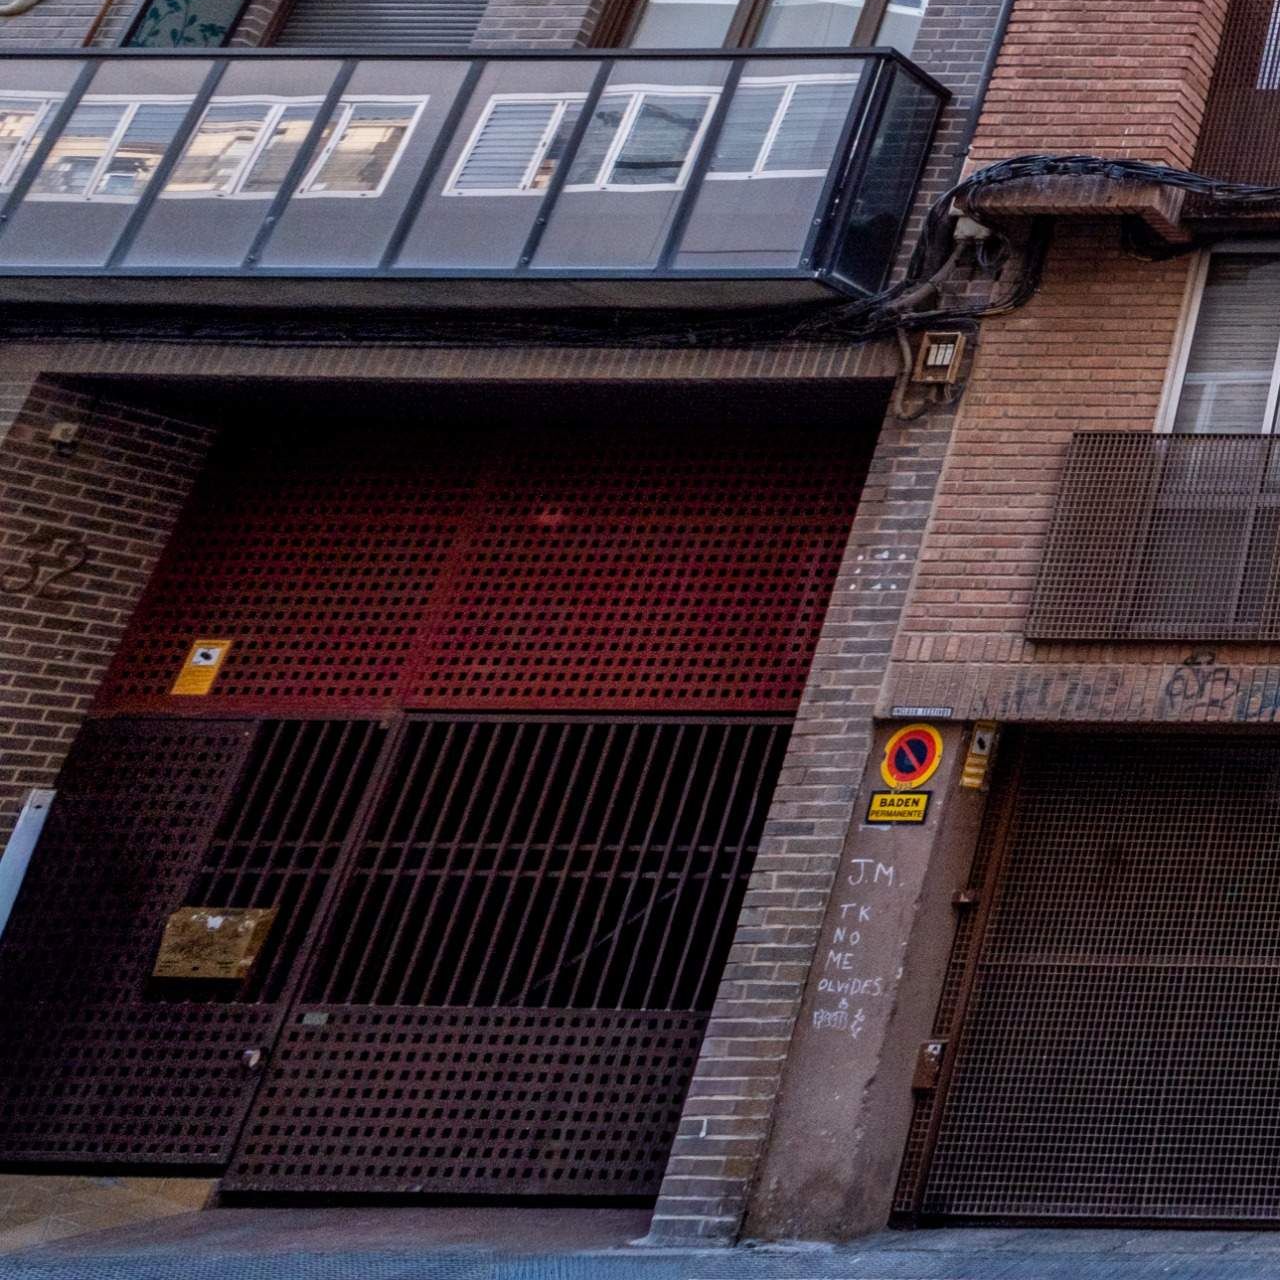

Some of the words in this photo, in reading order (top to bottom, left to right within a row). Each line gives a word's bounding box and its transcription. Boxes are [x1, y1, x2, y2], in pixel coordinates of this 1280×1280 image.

[879, 798, 920, 808] BADEN
[870, 809, 924, 818] PERMANENTE
[833, 927, 861, 946] NO
[824, 949, 855, 972] ME
